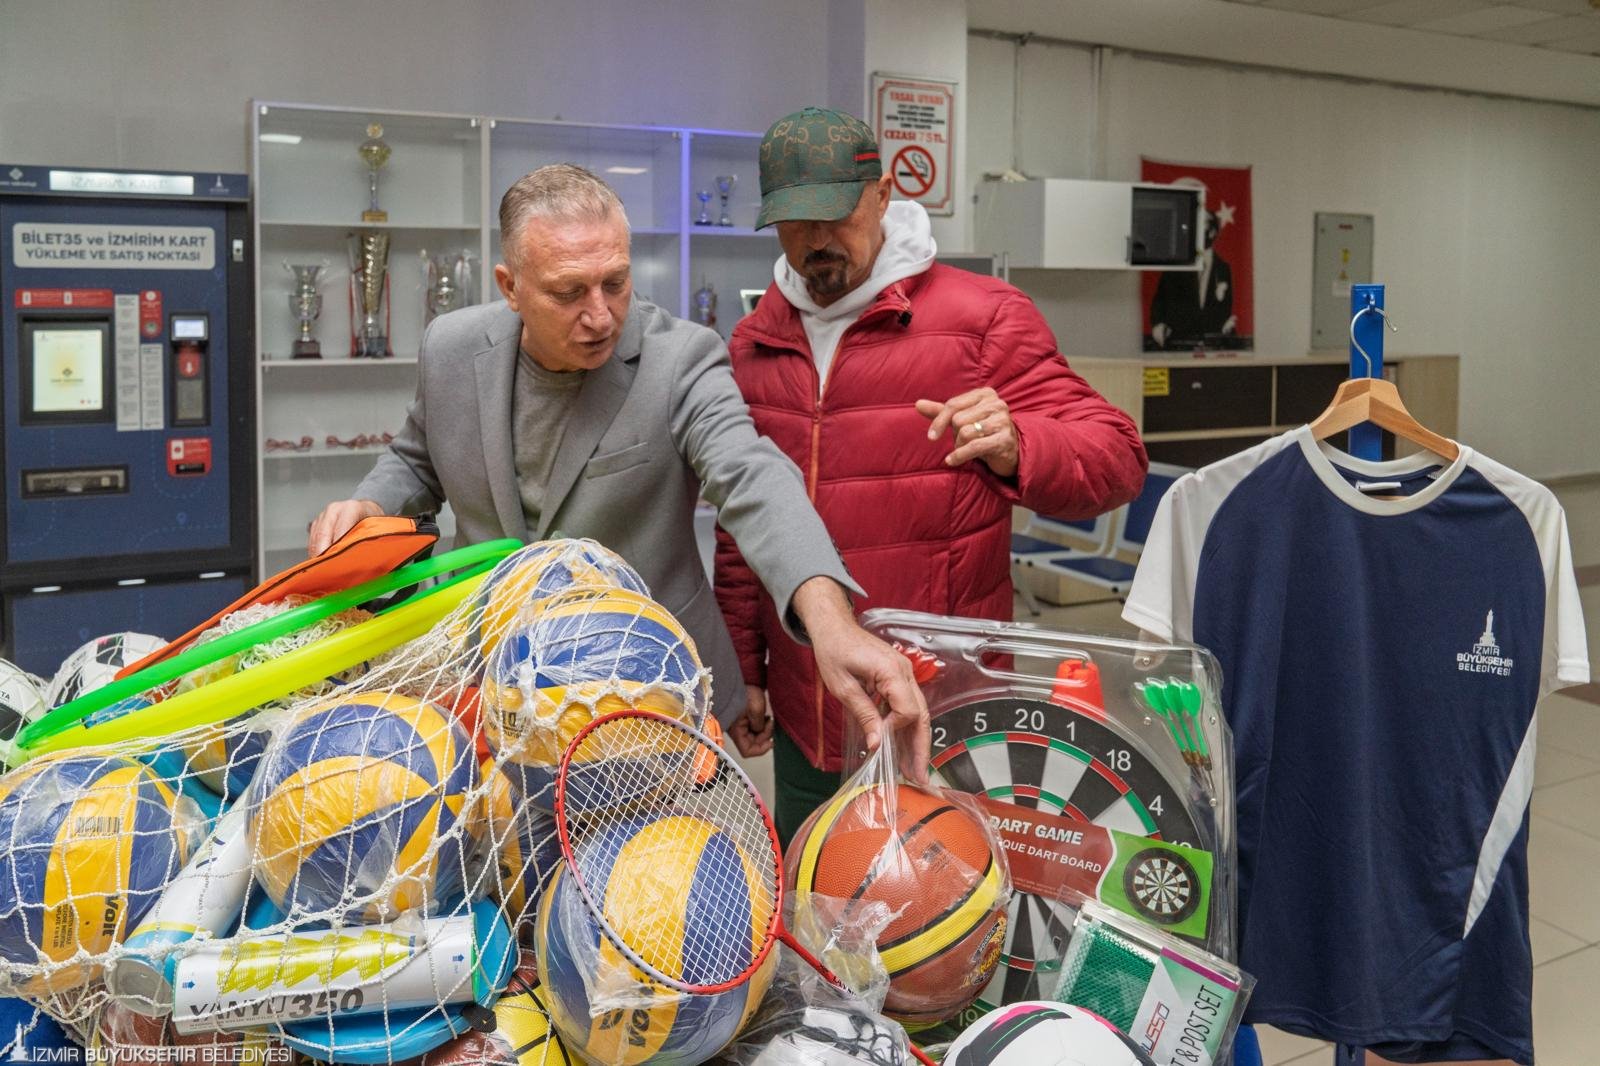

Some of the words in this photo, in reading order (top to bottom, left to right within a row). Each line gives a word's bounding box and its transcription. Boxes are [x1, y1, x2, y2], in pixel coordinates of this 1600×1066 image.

[21, 230, 82, 245] BİLET35
[87, 235, 104, 246] ve
[108, 231, 164, 247] İZMİRİM
[169, 236, 207, 247] KART
[26, 247, 86, 260] YÜKLEME
[91, 250, 106, 260] VE
[109, 250, 143, 262] SATIŞ
[147, 250, 200, 262] NOKTASI
[1456, 652, 1513, 668] BÜYÜKŞEHİR
[1458, 662, 1511, 677] BELEDİYESİ
[974, 712, 988, 732] 5
[1014, 708, 1045, 731] 20
[1066, 721, 1076, 742] 1
[1106, 749, 1132, 771] 18
[1148, 795, 1164, 816] 4
[989, 815, 1033, 834] DART
[1035, 824, 1084, 845] GAME
[1027, 849, 1060, 861] DART
[1060, 853, 1102, 873] BOARD
[1193, 984, 1224, 1017] SET
[1179, 1010, 1213, 1052] POST
[1175, 1048, 1200, 1063] &
